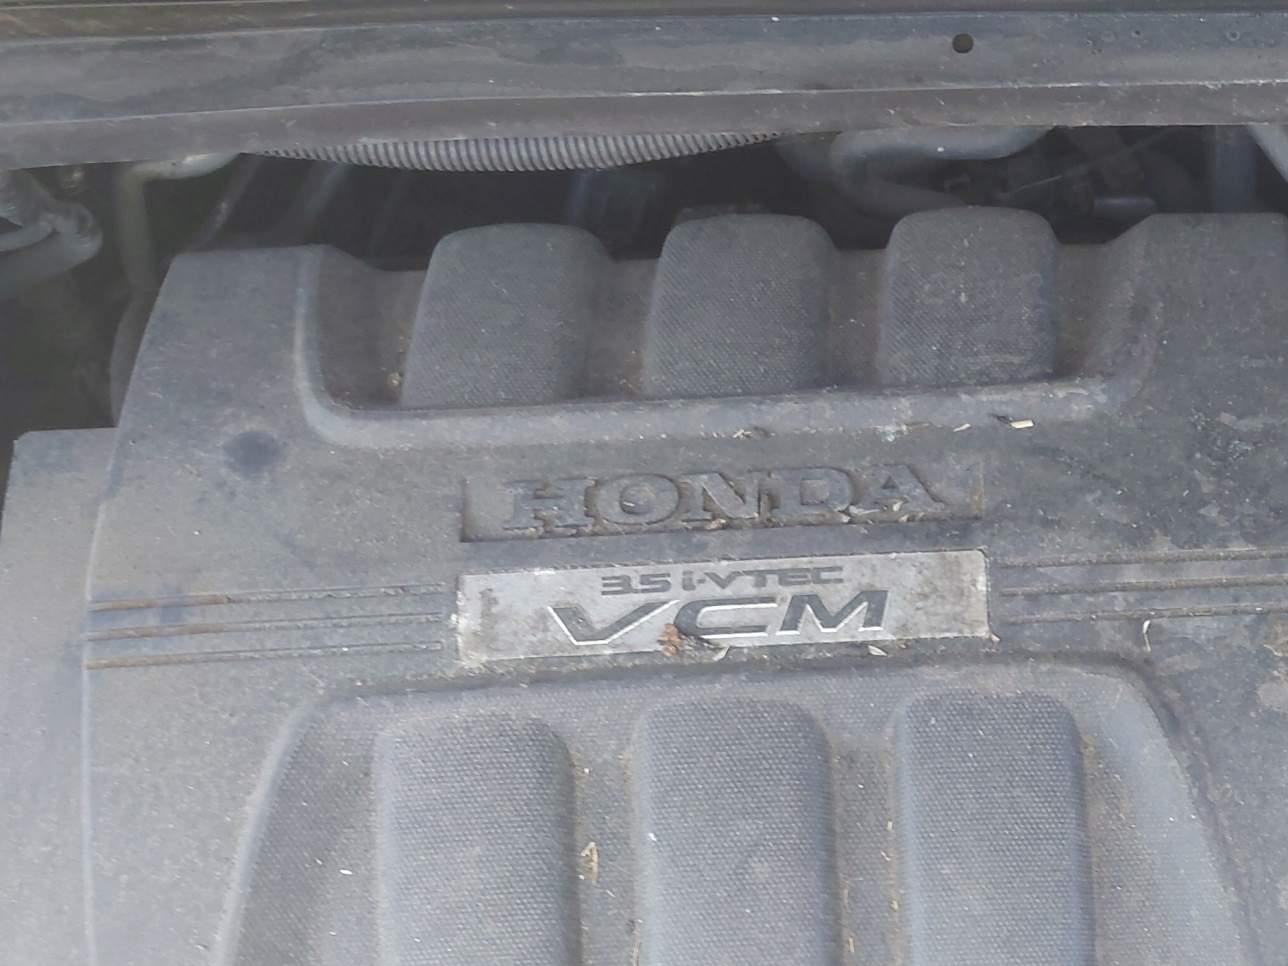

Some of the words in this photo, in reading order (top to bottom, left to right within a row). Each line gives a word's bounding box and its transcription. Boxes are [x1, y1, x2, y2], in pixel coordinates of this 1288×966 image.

[502, 463, 947, 530] HONDA
[681, 566, 843, 591] i-VTEC
[547, 590, 889, 646] VCM
